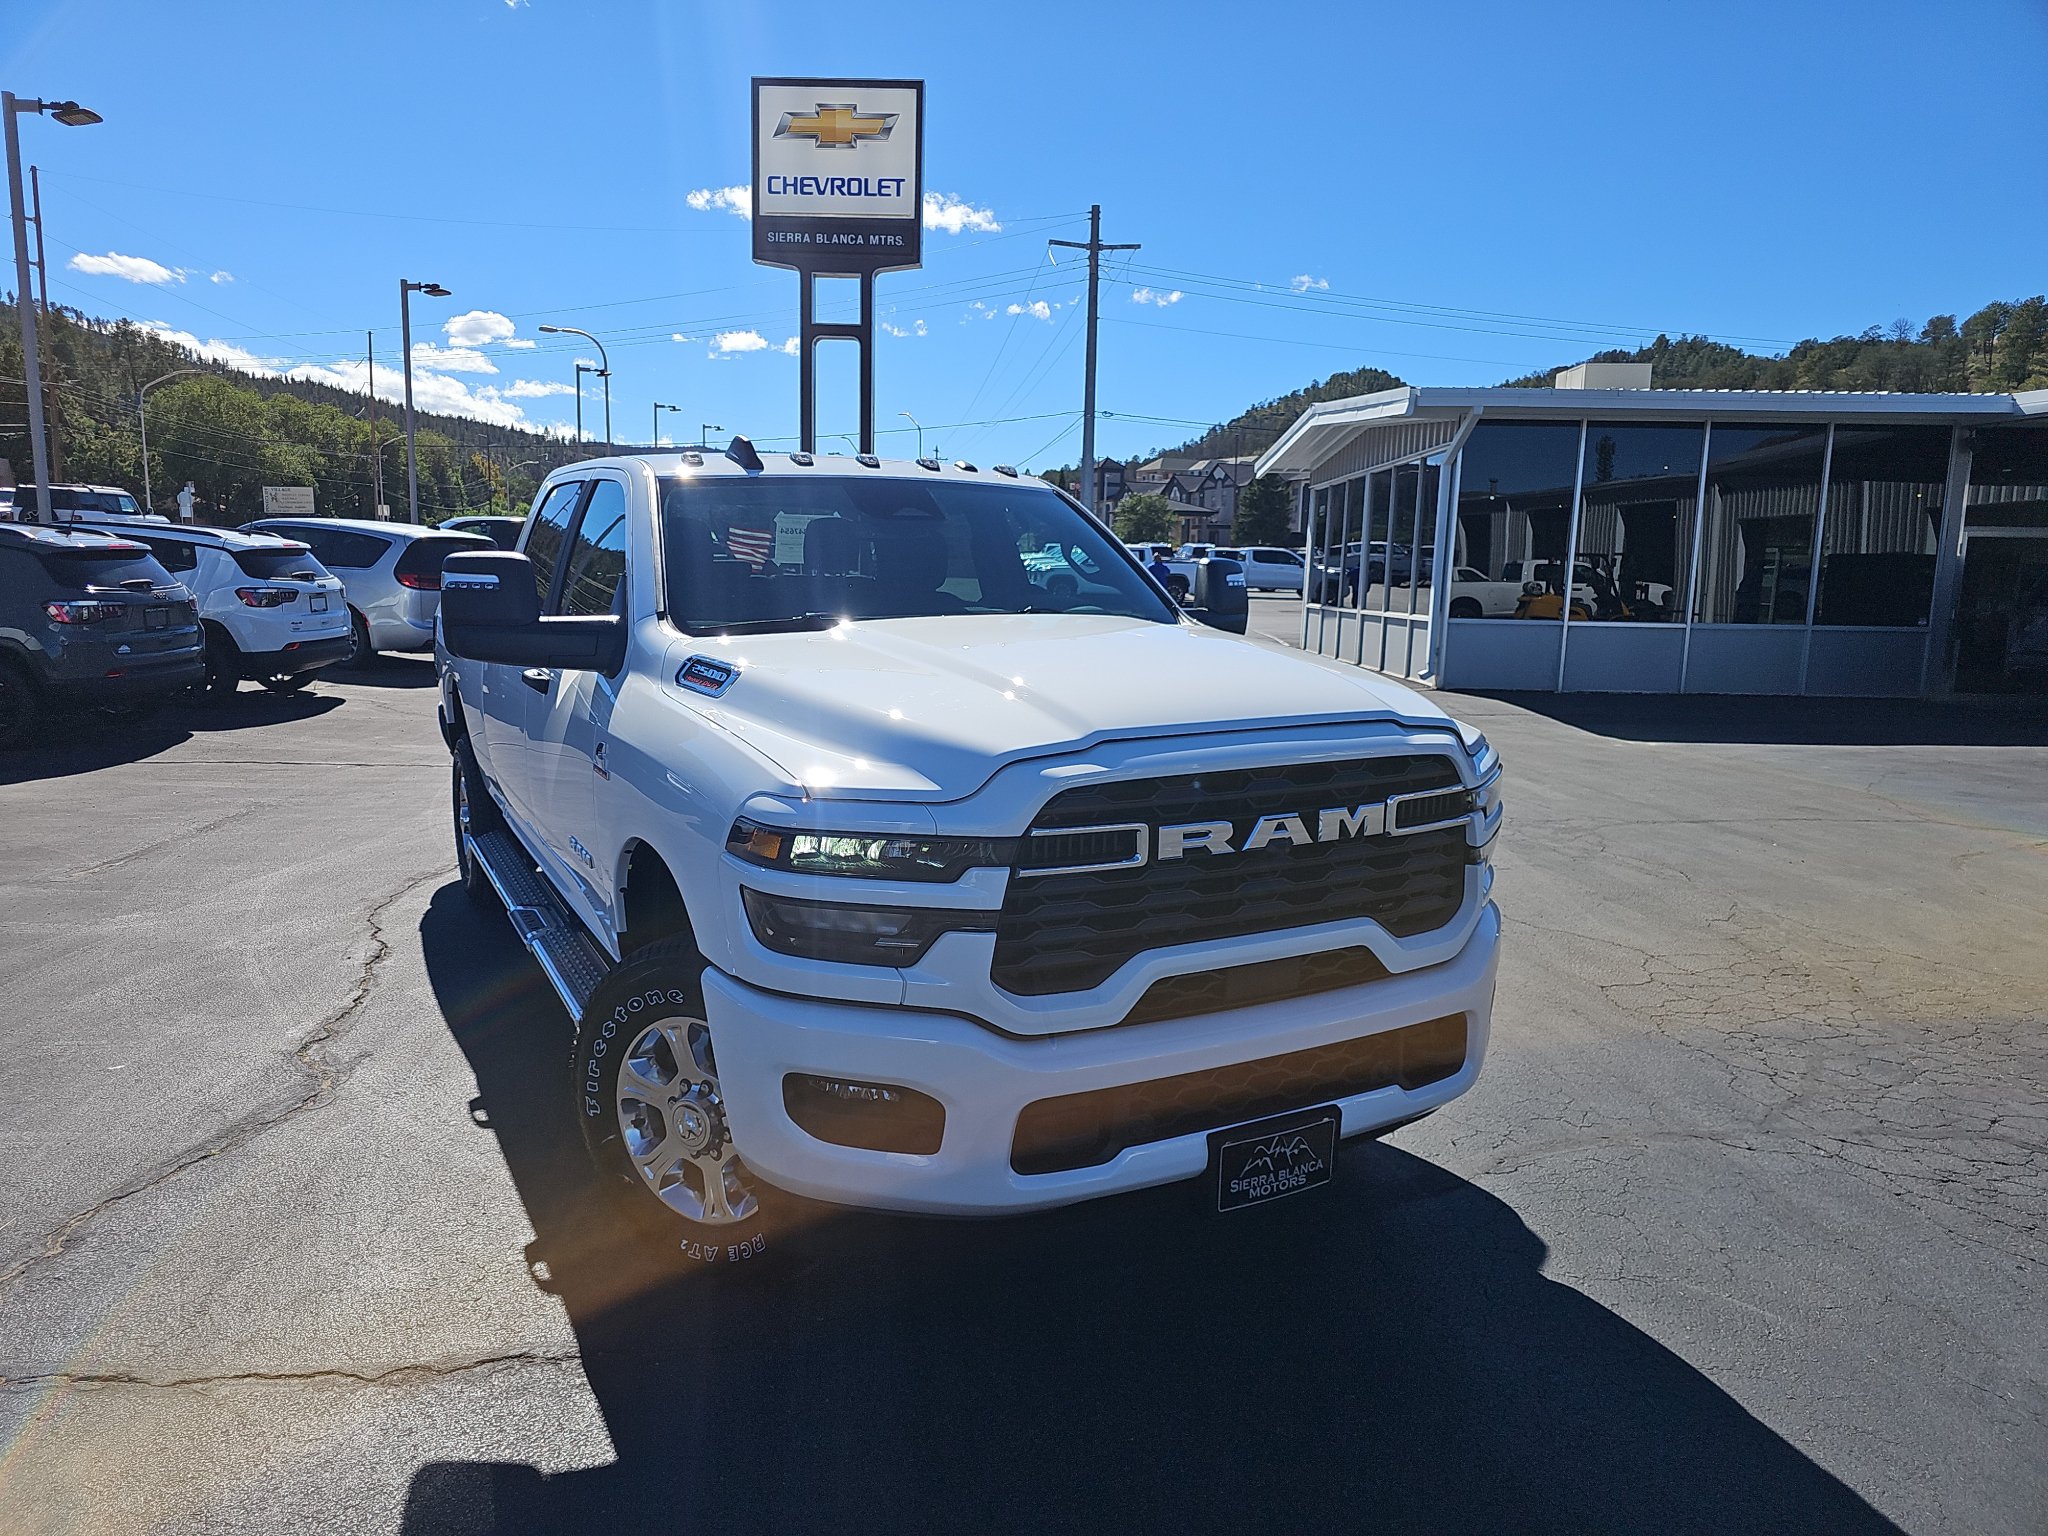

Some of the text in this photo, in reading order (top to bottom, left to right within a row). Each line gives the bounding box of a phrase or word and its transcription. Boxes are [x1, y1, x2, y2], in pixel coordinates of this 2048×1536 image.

[767, 175, 906, 197] CHEVROLET
[767, 231, 905, 246] SIERRA BLANCA MTRS.
[691, 663, 728, 682] 2500
[1158, 802, 1386, 861] RAM
[585, 988, 684, 1118] Firestone
[1230, 1159, 1324, 1193] SIERRA BLANCA
[1249, 1174, 1307, 1199] MOTORS
